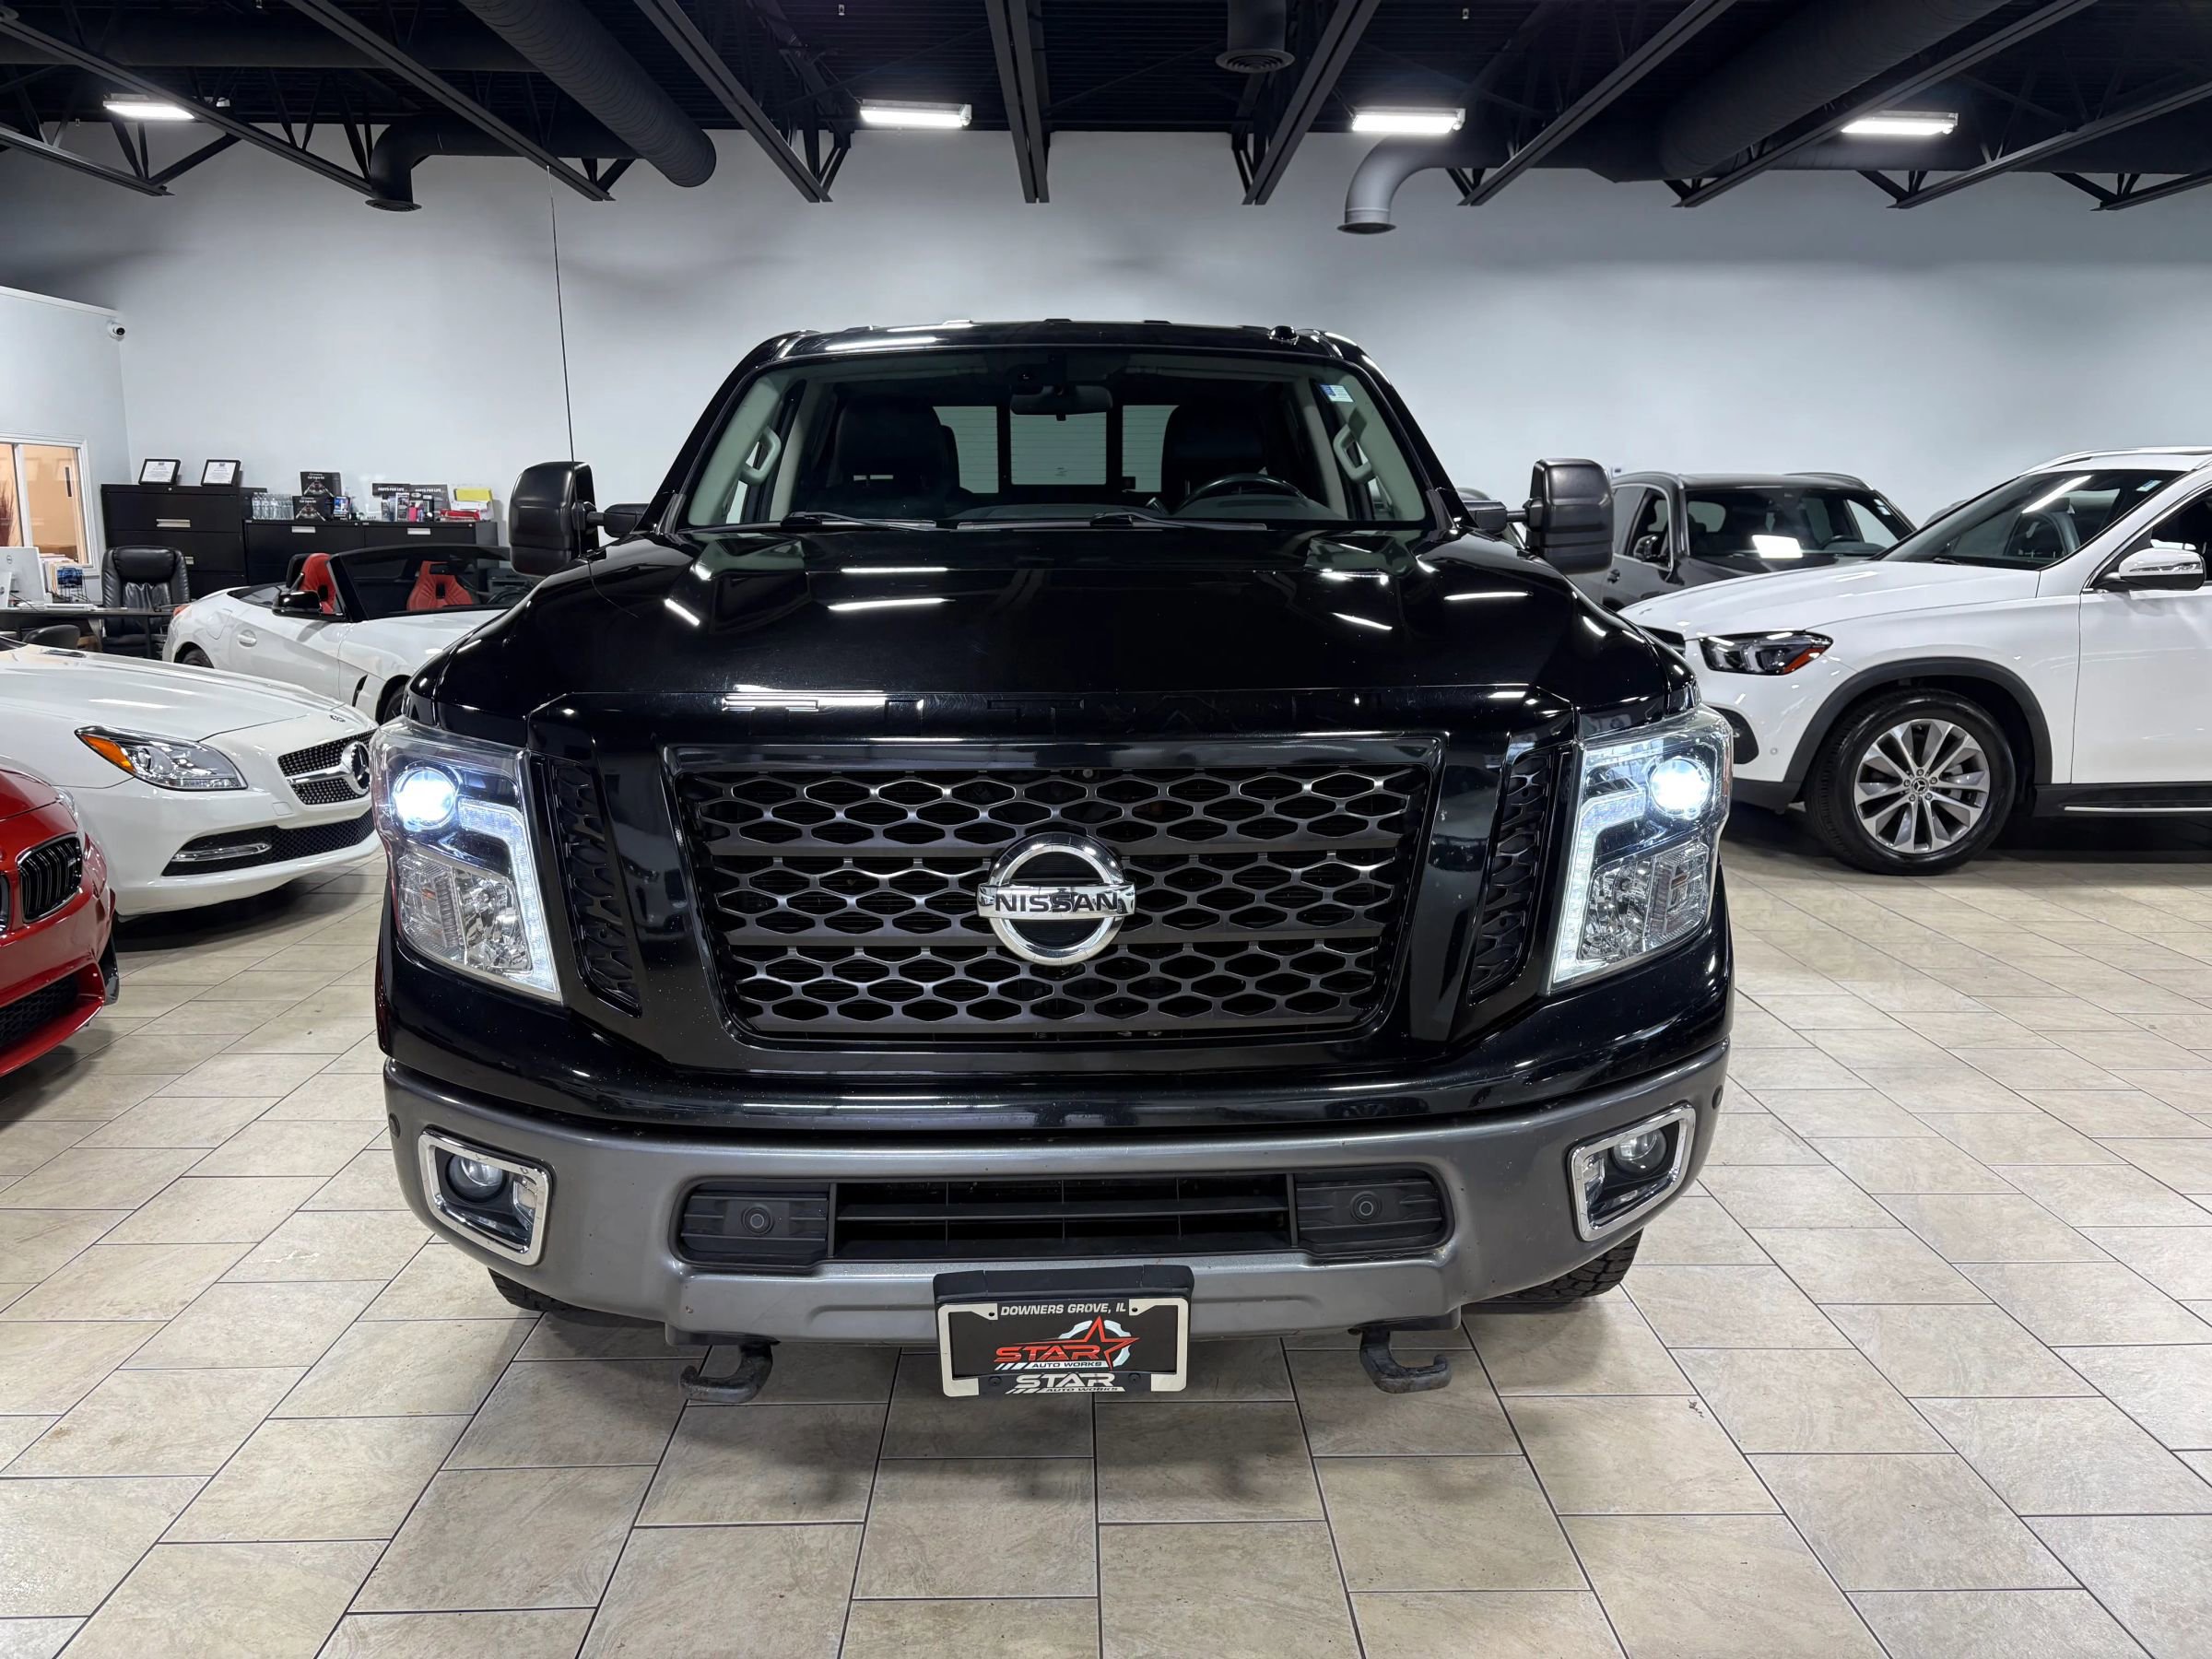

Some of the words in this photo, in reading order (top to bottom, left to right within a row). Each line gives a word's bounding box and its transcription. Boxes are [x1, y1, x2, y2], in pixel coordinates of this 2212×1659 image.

[995, 891, 1118, 913] NISSAN
[1000, 1304, 1064, 1316] DOWNERS
[1067, 1303, 1112, 1314] GROVE,
[1115, 1302, 1126, 1312] IL
[994, 1344, 1100, 1362] STAR
[1014, 1372, 1115, 1389] STAR
